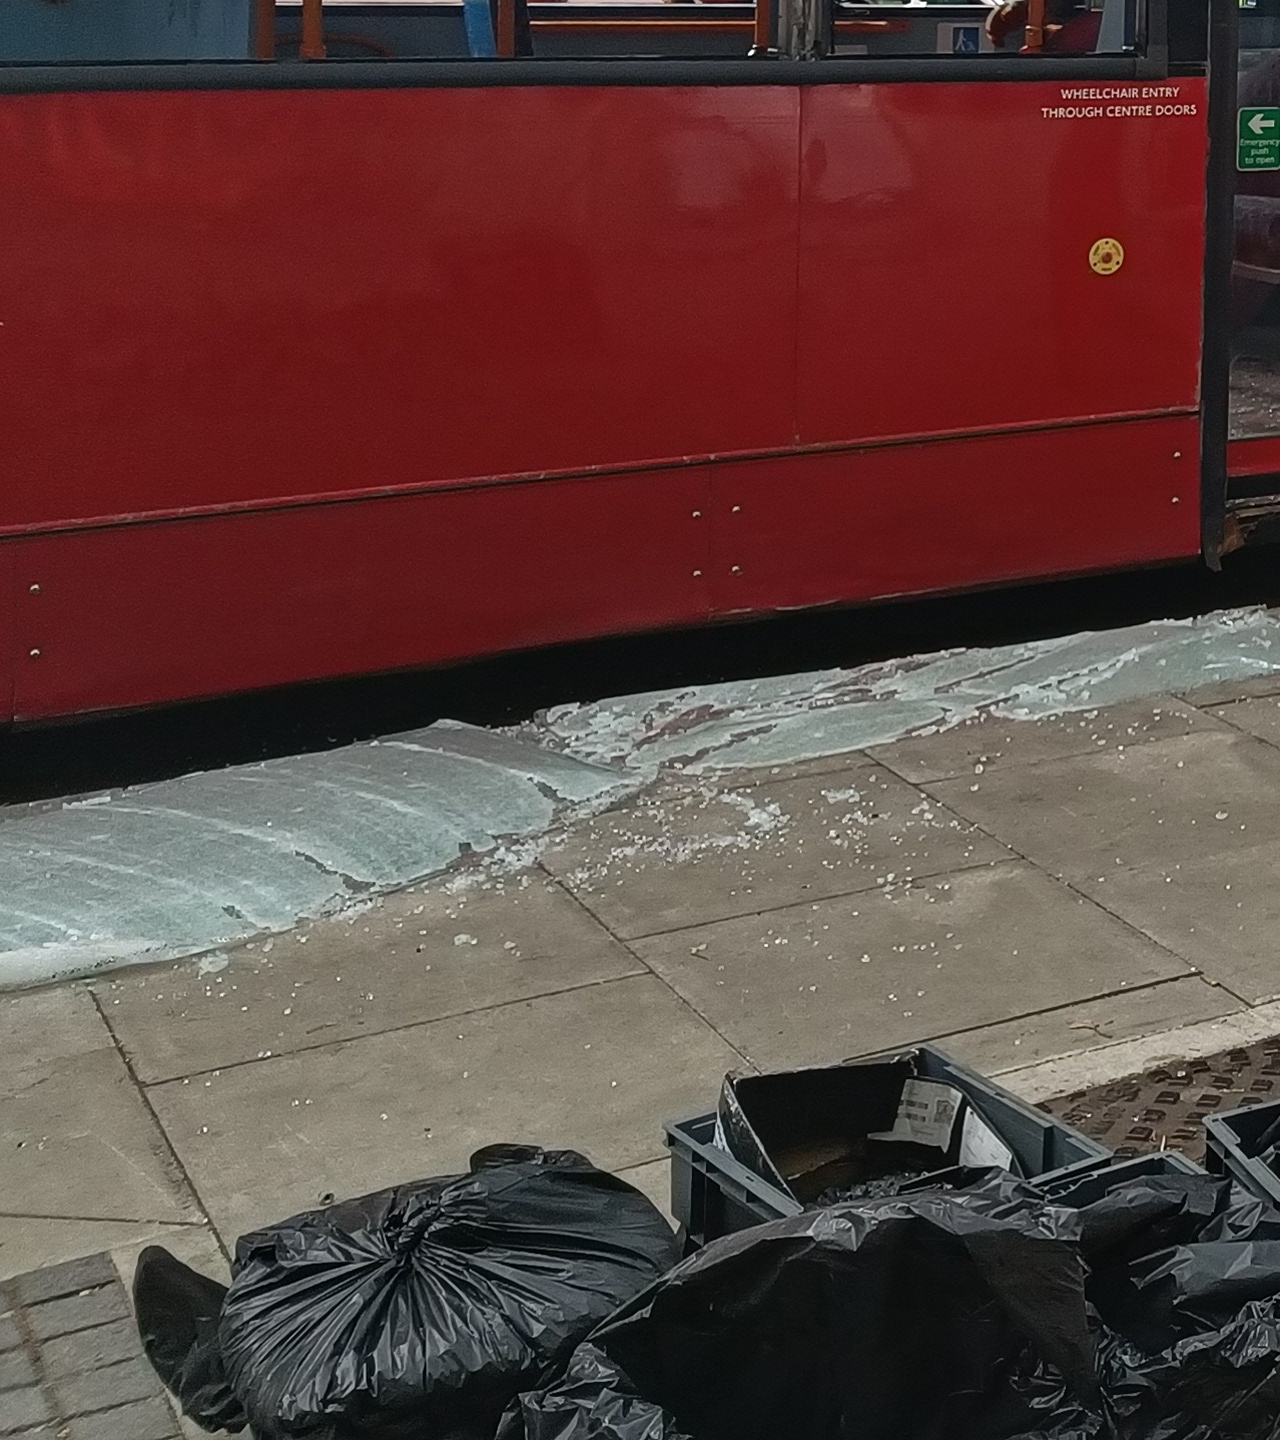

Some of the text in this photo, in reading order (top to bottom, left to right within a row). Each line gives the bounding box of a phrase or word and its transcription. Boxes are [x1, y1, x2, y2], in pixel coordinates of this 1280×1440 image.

[1060, 87, 1180, 100] WHEELCHAIR ENTRY
[1041, 104, 1197, 119] THROUGH CENTRE DOORS
[1239, 138, 1280, 148] Emergency
